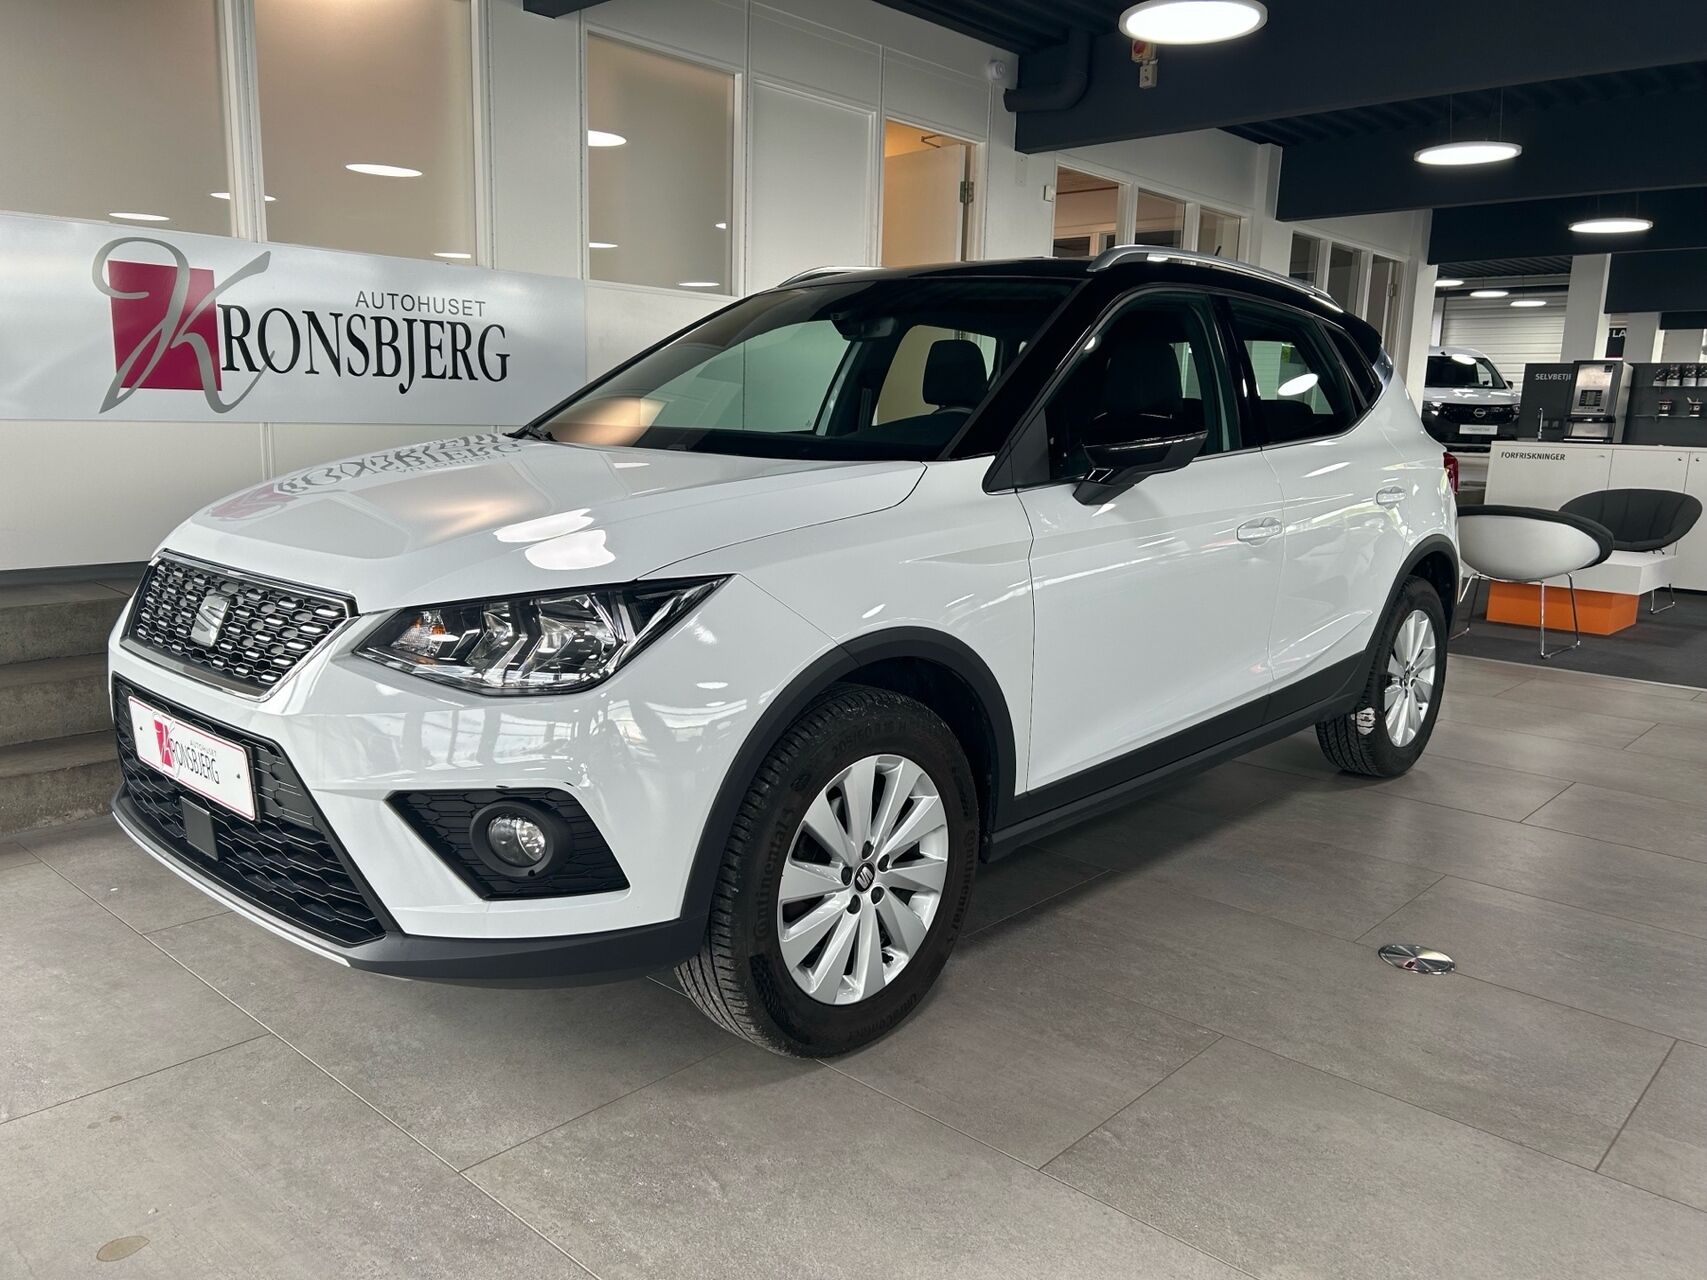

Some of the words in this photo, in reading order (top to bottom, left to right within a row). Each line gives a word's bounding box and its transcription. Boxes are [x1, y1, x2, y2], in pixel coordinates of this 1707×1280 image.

[91, 236, 511, 414] KRONSBJERG
[355, 290, 487, 318] AUTOHUSET
[1500, 451, 1566, 461] FORFRISKNINGER
[754, 821, 790, 938] Continental
